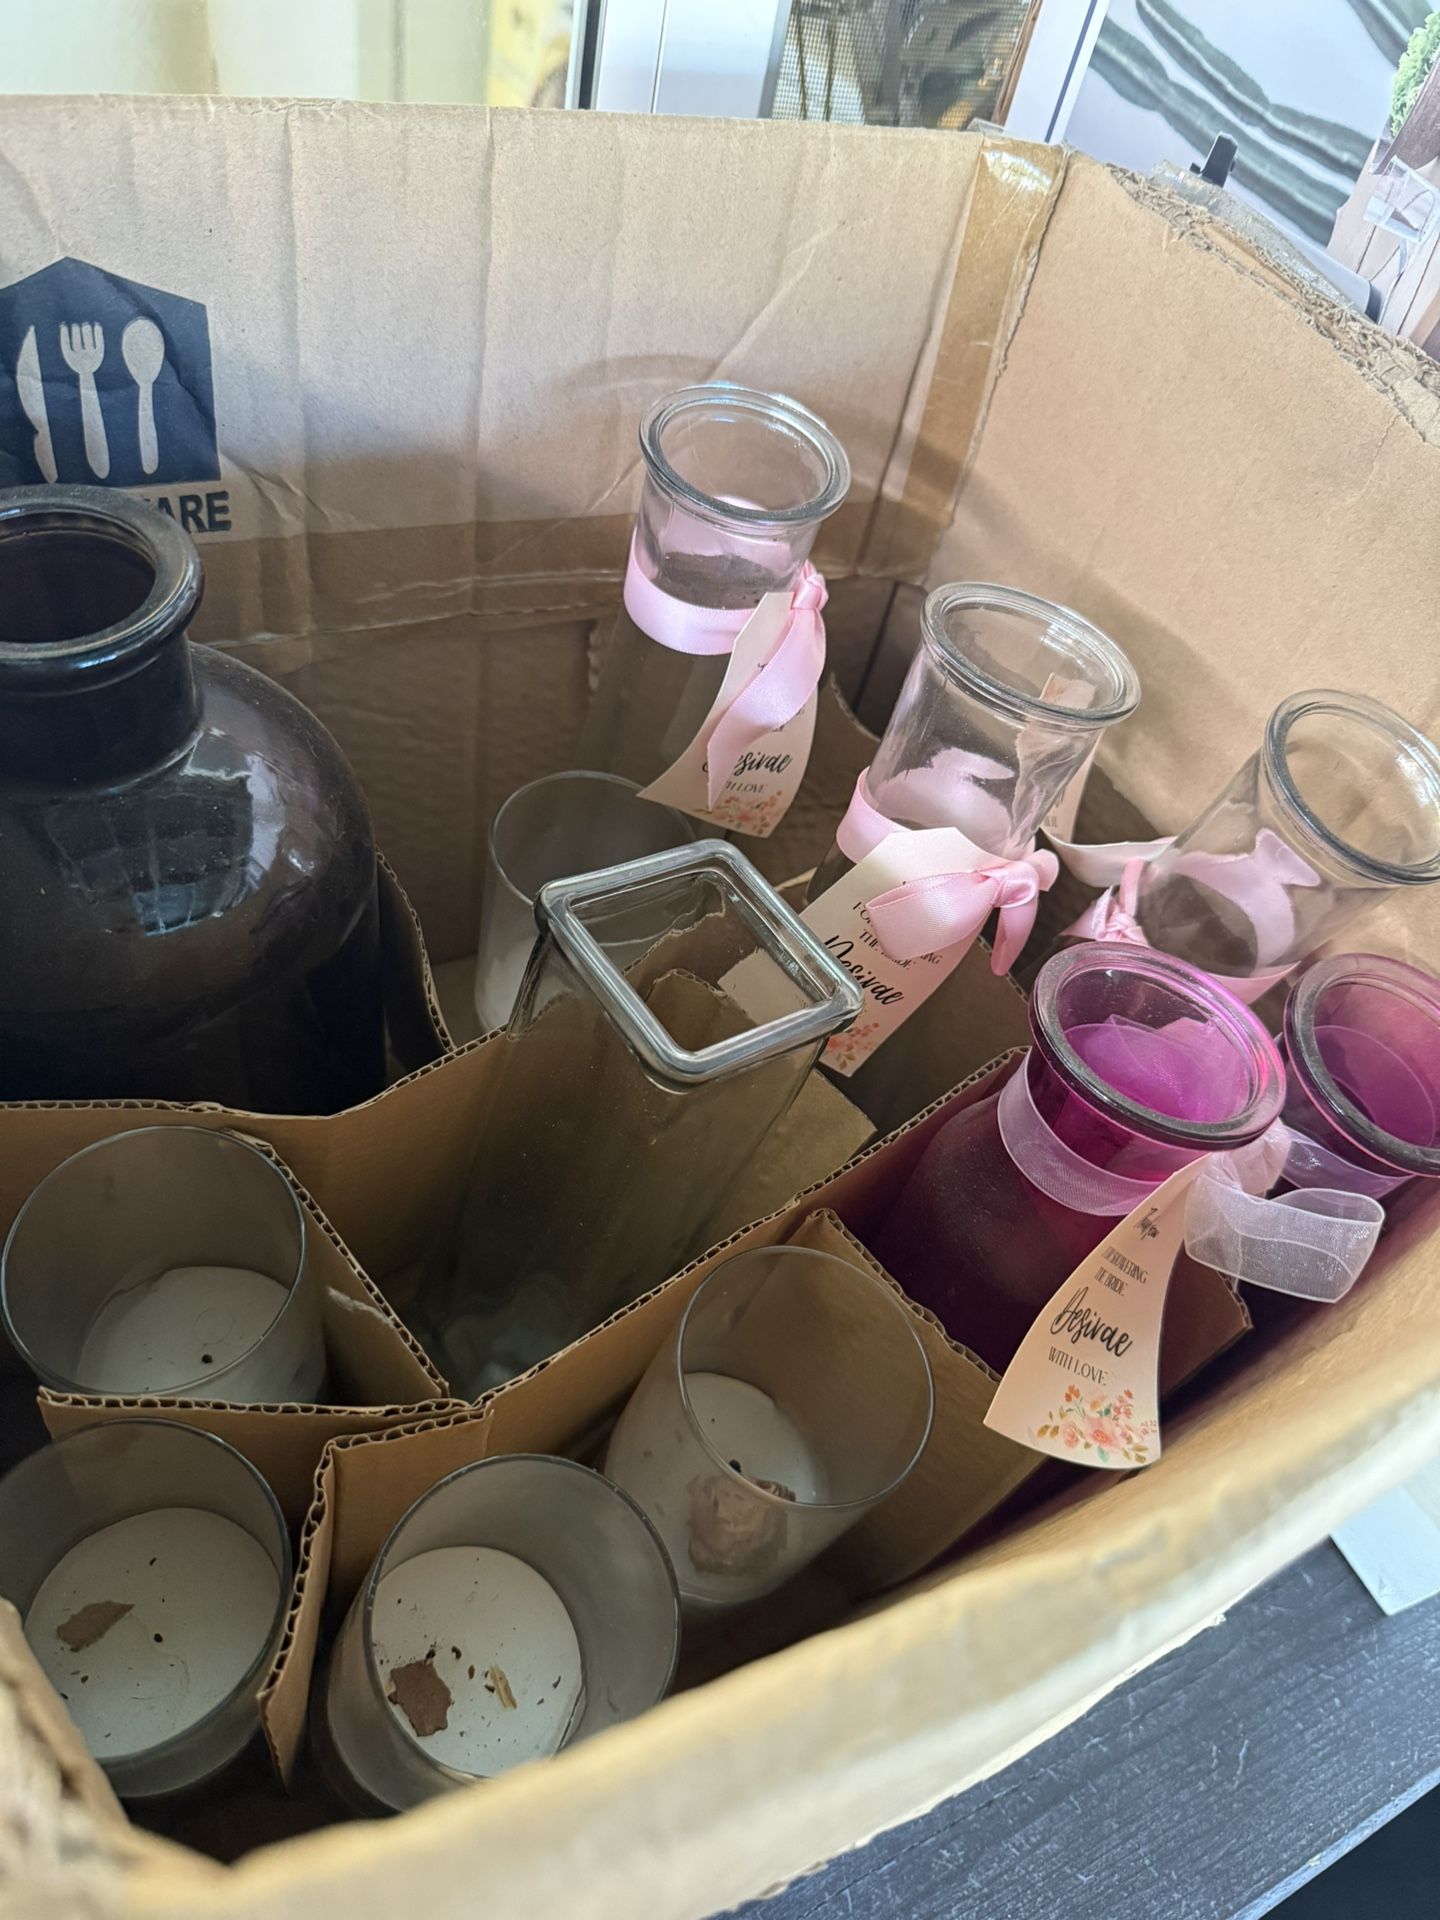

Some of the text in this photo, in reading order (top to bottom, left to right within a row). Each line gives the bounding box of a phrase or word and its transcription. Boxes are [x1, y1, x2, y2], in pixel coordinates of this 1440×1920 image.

[1050, 1285, 1134, 1358] Desirae
[1048, 1345, 1109, 1387] WITH LOVE
